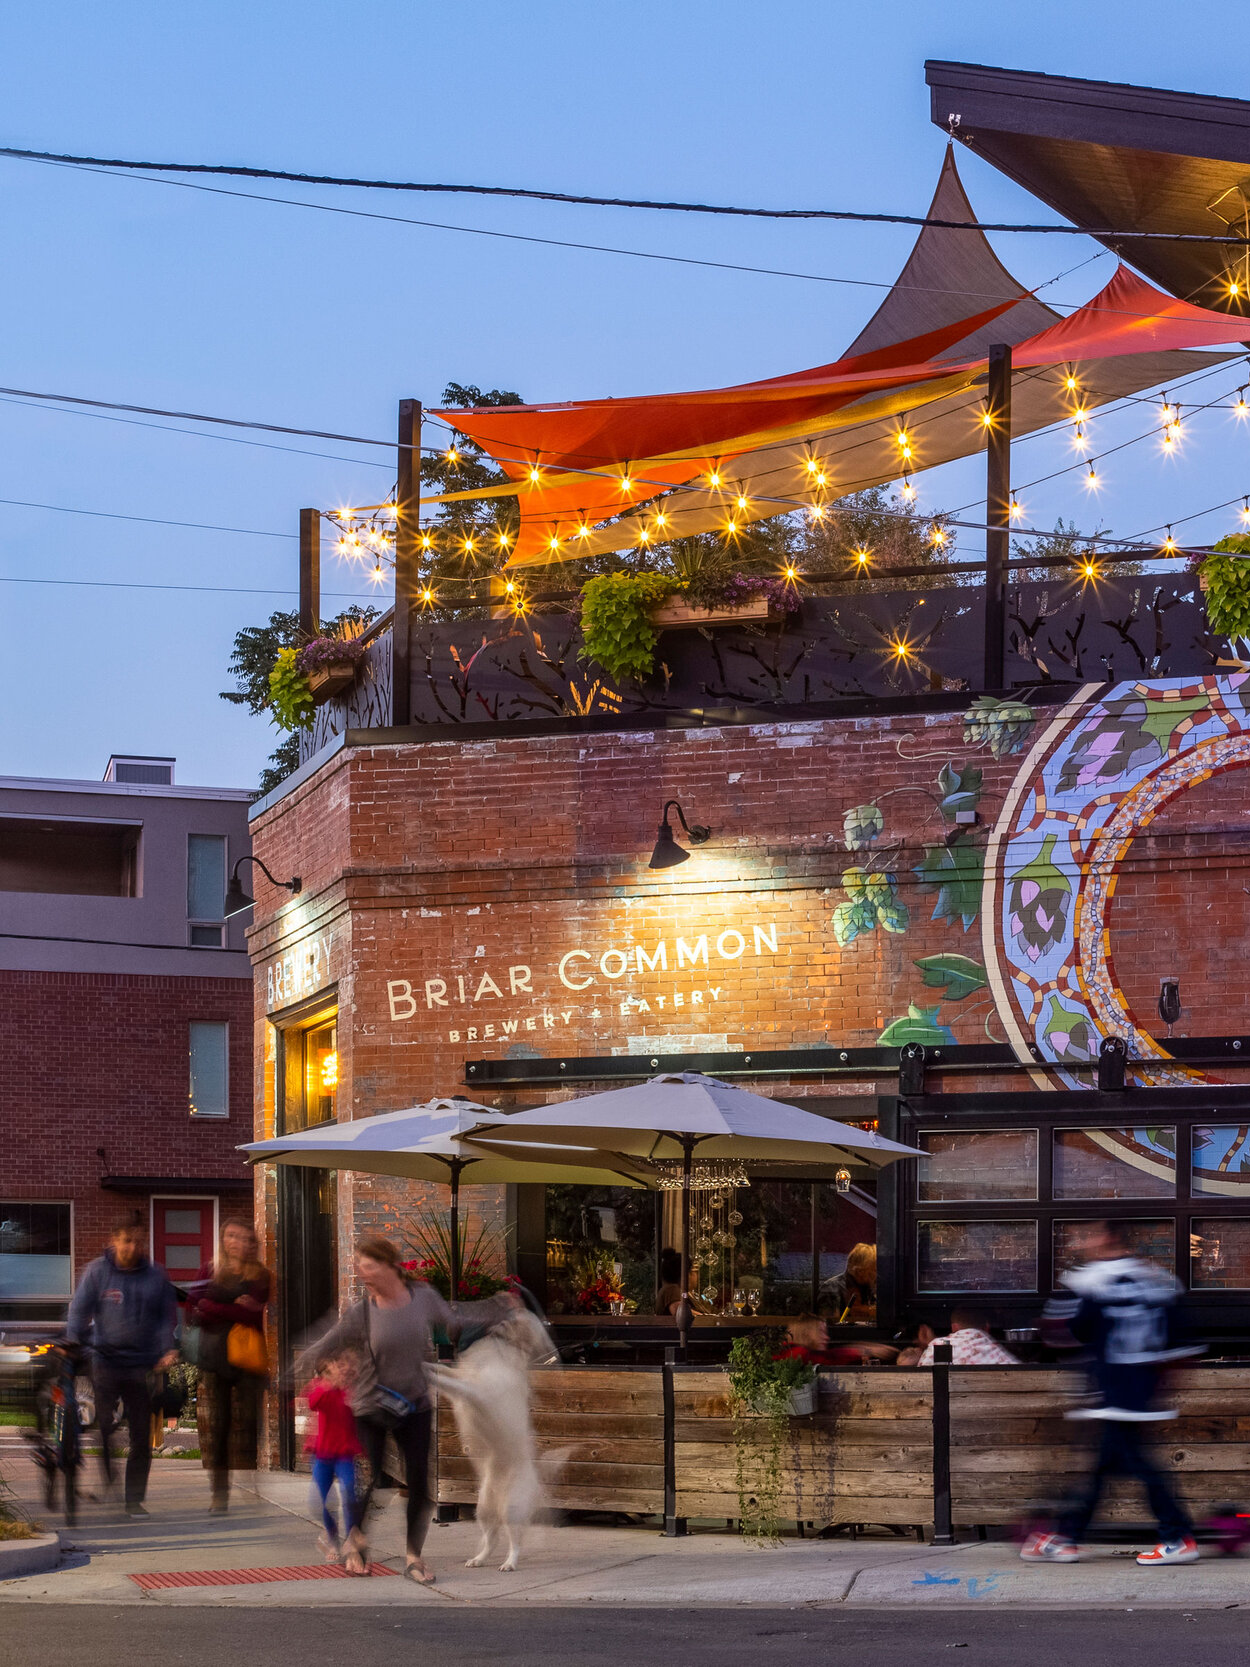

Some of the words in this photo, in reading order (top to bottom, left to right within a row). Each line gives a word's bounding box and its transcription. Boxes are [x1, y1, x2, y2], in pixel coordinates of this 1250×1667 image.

[387, 965, 534, 1021] BRIAR
[558, 923, 780, 991] COMMON
[448, 1010, 573, 1044] BREWERY
[620, 985, 723, 1016] EATERY
